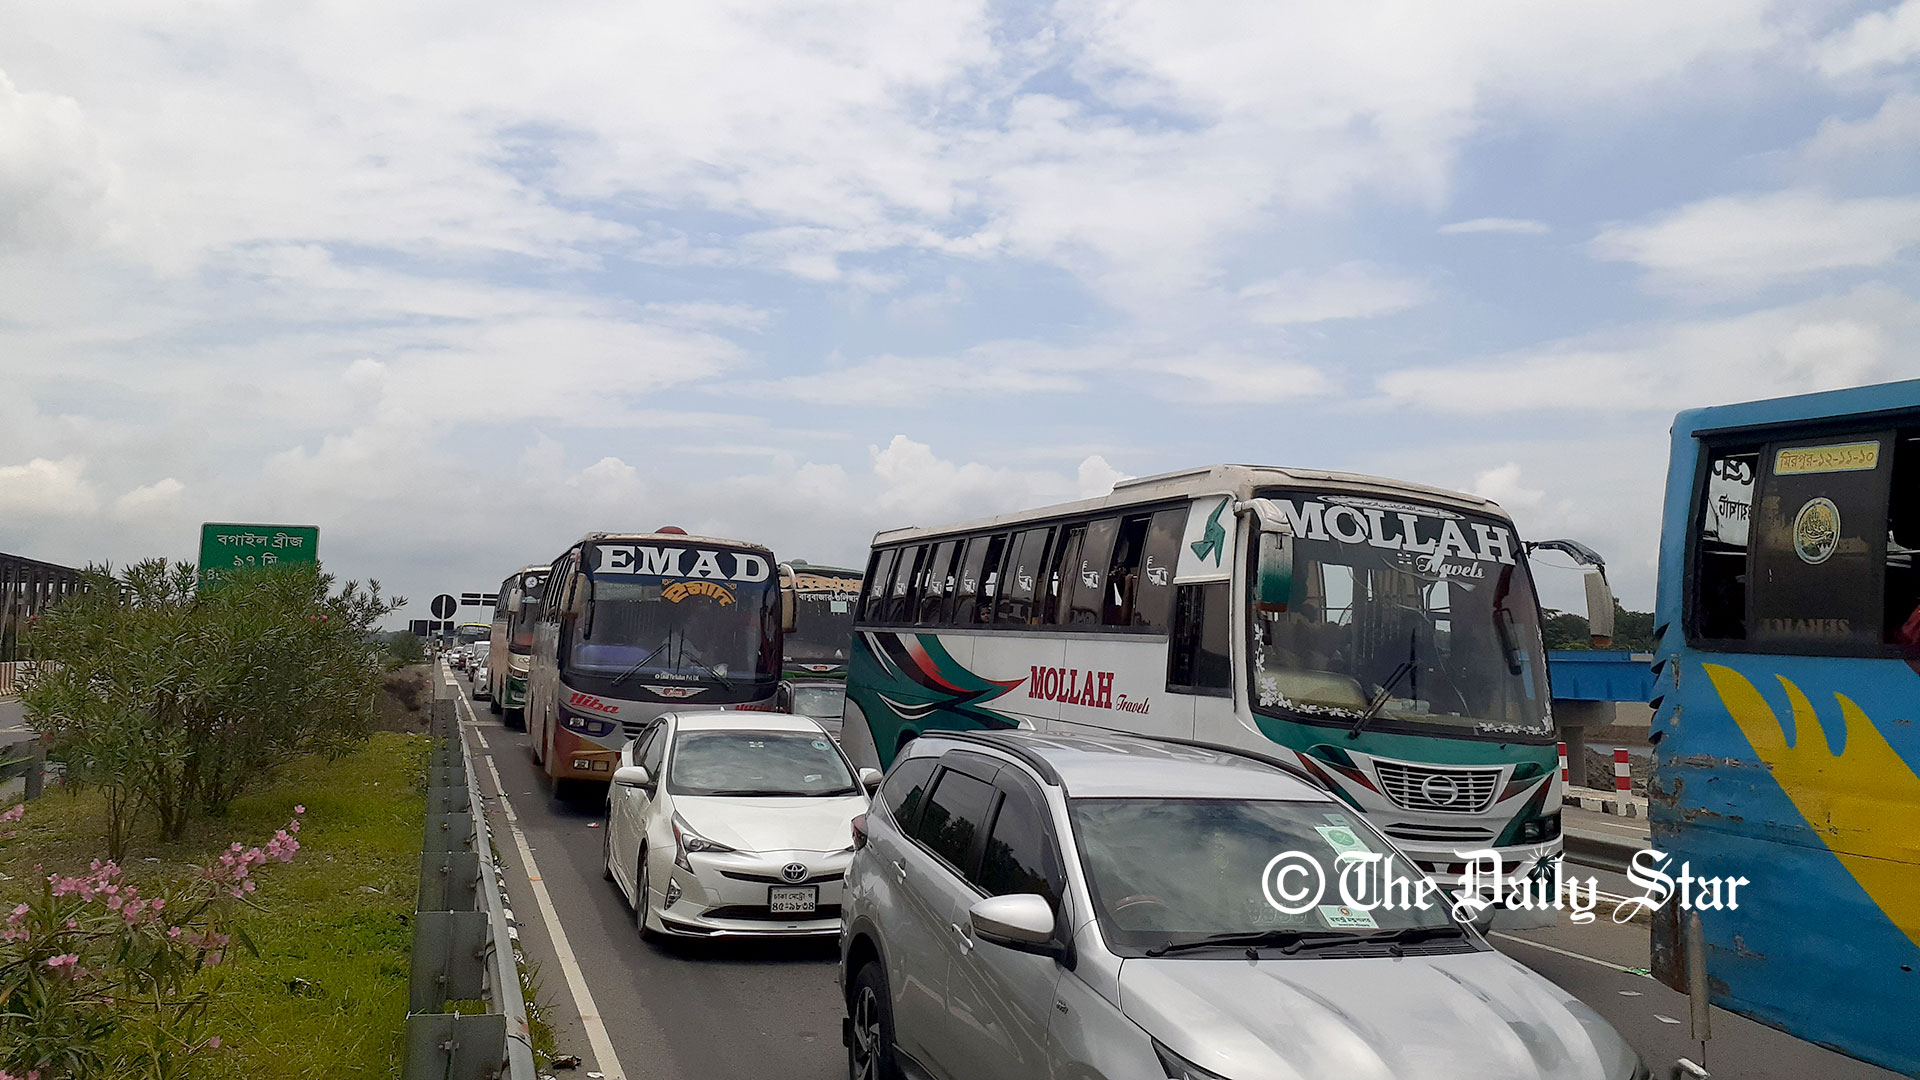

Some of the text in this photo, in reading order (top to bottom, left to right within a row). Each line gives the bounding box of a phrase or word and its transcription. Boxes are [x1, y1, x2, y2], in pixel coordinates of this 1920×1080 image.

[217, 532, 304, 549] বগাইল ব্রীজ
[1271, 499, 1516, 565] MOLLAH
[593, 545, 770, 583] EMAD
[1416, 554, 1485, 578] Travels
[1028, 665, 1150, 714] MOLLAH Travels
